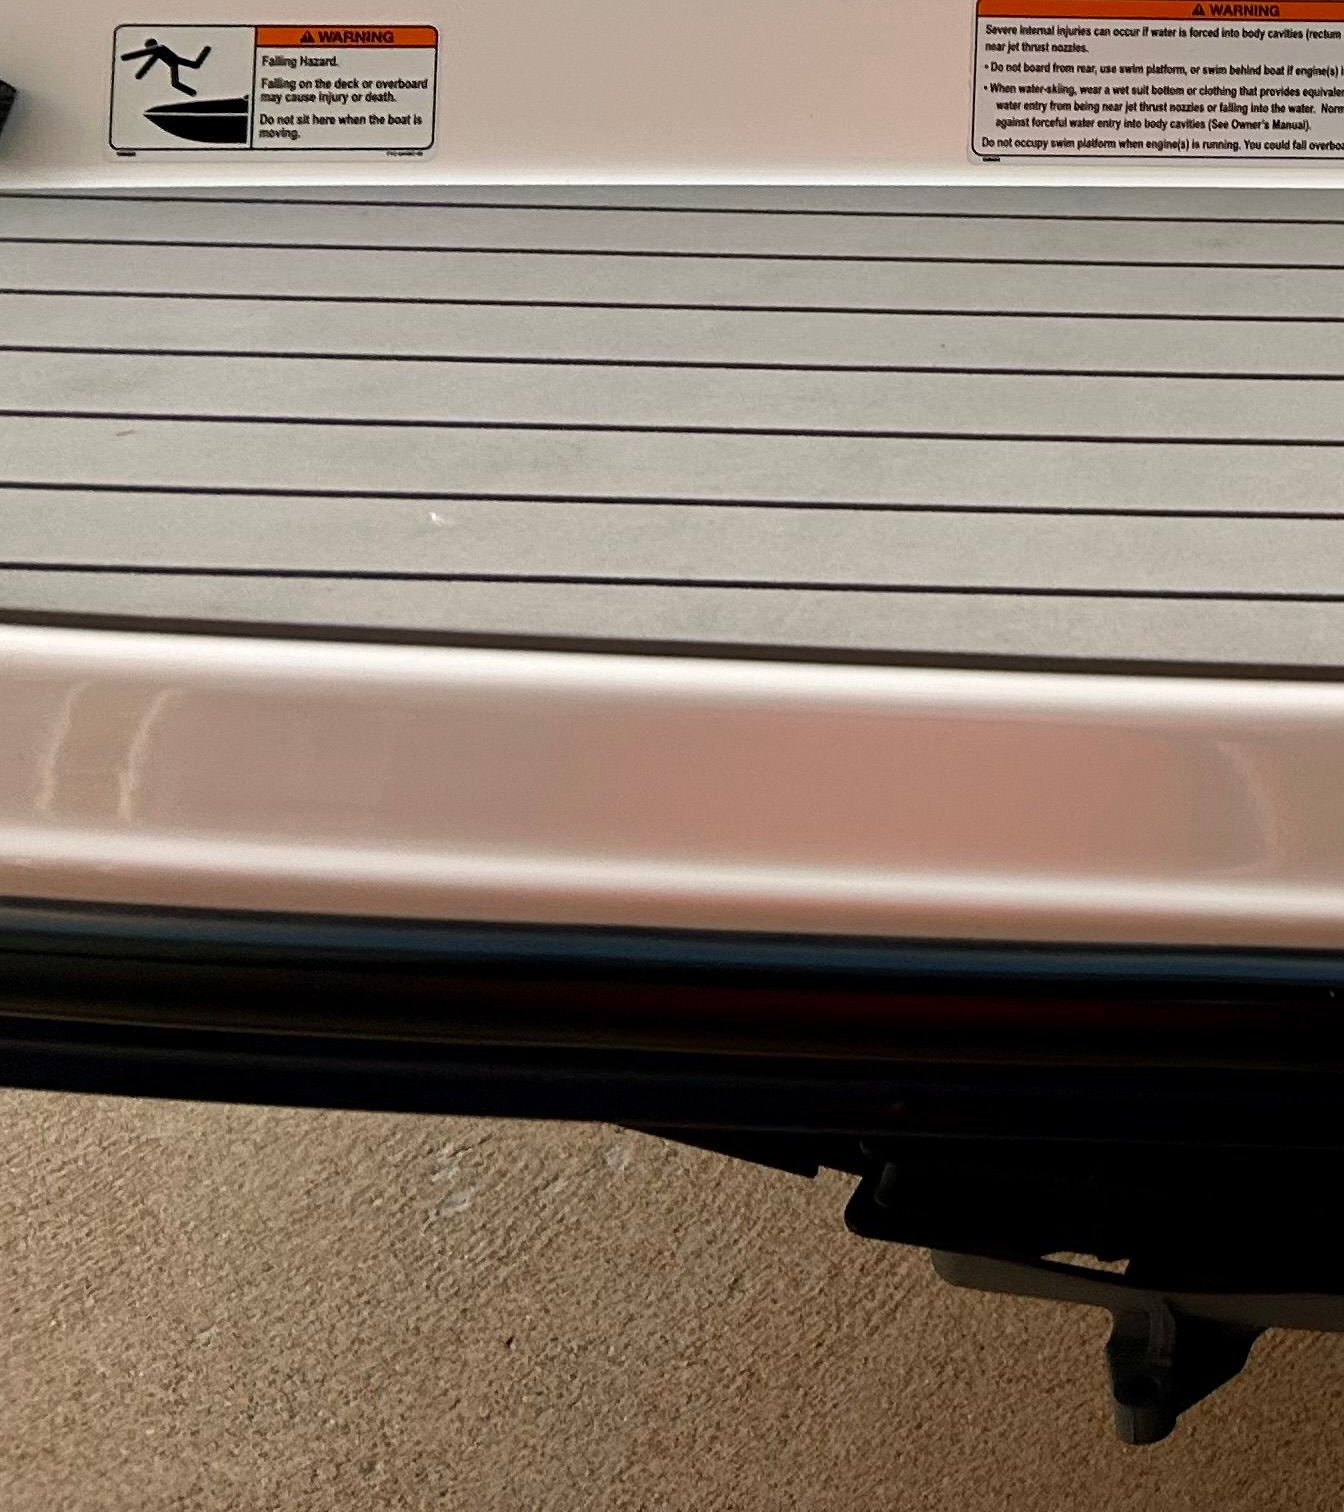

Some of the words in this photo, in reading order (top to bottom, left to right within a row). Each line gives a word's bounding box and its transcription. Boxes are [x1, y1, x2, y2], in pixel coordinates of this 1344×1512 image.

[1210, 4, 1280, 16] WARNING
[318, 31, 394, 42] WARNING
[985, 24, 1017, 34] Severe
[1056, 25, 1091, 37] injuries
[1093, 28, 1110, 36] can
[1112, 28, 1140, 36] occur
[1142, 26, 1148, 36] if
[1150, 28, 1176, 36] water
[1178, 27, 1187, 37] is
[1189, 27, 1219, 37] forced
[1221, 27, 1239, 37] into
[1241, 28, 1265, 40] body
[1267, 28, 1303, 38] cavities
[985, 43, 1006, 51] near
[1006, 41, 1019, 53] jet
[1021, 42, 1049, 51] thrust
[262, 55, 297, 68] Falling
[990, 61, 1003, 71] Do
[1005, 62, 1021, 72] not
[1023, 62, 1050, 72] board
[1052, 62, 1074, 72] from
[1099, 65, 1116, 73] use
[1119, 64, 1143, 73] swim
[1190, 66, 1200, 74] or
[1202, 65, 1227, 74] swim
[1229, 64, 1261, 74] behind
[1263, 65, 1284, 75] boat
[1286, 65, 1293, 75] if
[1295, 66, 1338, 77] engine(s)
[261, 77, 296, 90] Falling
[298, 80, 312, 88] on
[314, 78, 332, 88] the
[334, 78, 359, 88] deck
[361, 80, 373, 88] or
[375, 79, 428, 88] overboard
[990, 83, 1016, 92] When
[1079, 86, 1102, 94] wear
[1104, 86, 1110, 94] a
[1112, 86, 1129, 94] wet
[1131, 85, 1149, 94] suit
[1151, 85, 1184, 94] bottom
[1186, 87, 1197, 95] or
[1198, 85, 1237, 97] clothing
[1239, 86, 1257, 95] that
[1259, 87, 1300, 97] provides
[260, 93, 282, 104] may
[285, 94, 316, 102] cause
[318, 91, 349, 104] injury
[351, 93, 363, 102] or
[364, 91, 397, 101] death.
[995, 101, 1021, 109] water
[1023, 101, 1047, 112] entry
[1049, 100, 1071, 110] from
[1073, 101, 1099, 113] being
[1102, 103, 1123, 111] near
[1125, 101, 1137, 113] jet
[1139, 101, 1167, 111] thrust
[1169, 102, 1204, 112] nozzles
[1206, 104, 1217, 112] or
[1219, 102, 1248, 114] falling
[1250, 102, 1269, 112] into
[1271, 103, 1285, 112] the
[1288, 104, 1315, 113] water.
[259, 113, 274, 124] Do
[276, 115, 294, 124] not
[296, 114, 310, 124] sit
[312, 114, 336, 124] here
[338, 114, 366, 124] when
[368, 114, 385, 124] the
[387, 114, 411, 124] boat
[413, 114, 422, 124] is
[995, 117, 1029, 128] against
[1031, 117, 1067, 127] forceful
[1069, 118, 1095, 127] water
[1096, 119, 1121, 129] entry
[1123, 118, 1142, 127] into
[1144, 118, 1167, 130] body
[1169, 119, 1205, 128] cavities
[1208, 119, 1229, 130] (See
[258, 128, 300, 139] moving.
[981, 137, 995, 147] Do
[997, 138, 1012, 147] not
[1014, 139, 1048, 149] occupy
[1050, 138, 1074, 147] swim
[1077, 138, 1116, 149] platform
[1118, 138, 1143, 148] when
[1145, 139, 1189, 150] engine(s)
[1191, 138, 1200, 148] is
[1243, 139, 1261, 149] You
[1263, 140, 1290, 149] could
[1292, 140, 1306, 149] fall
